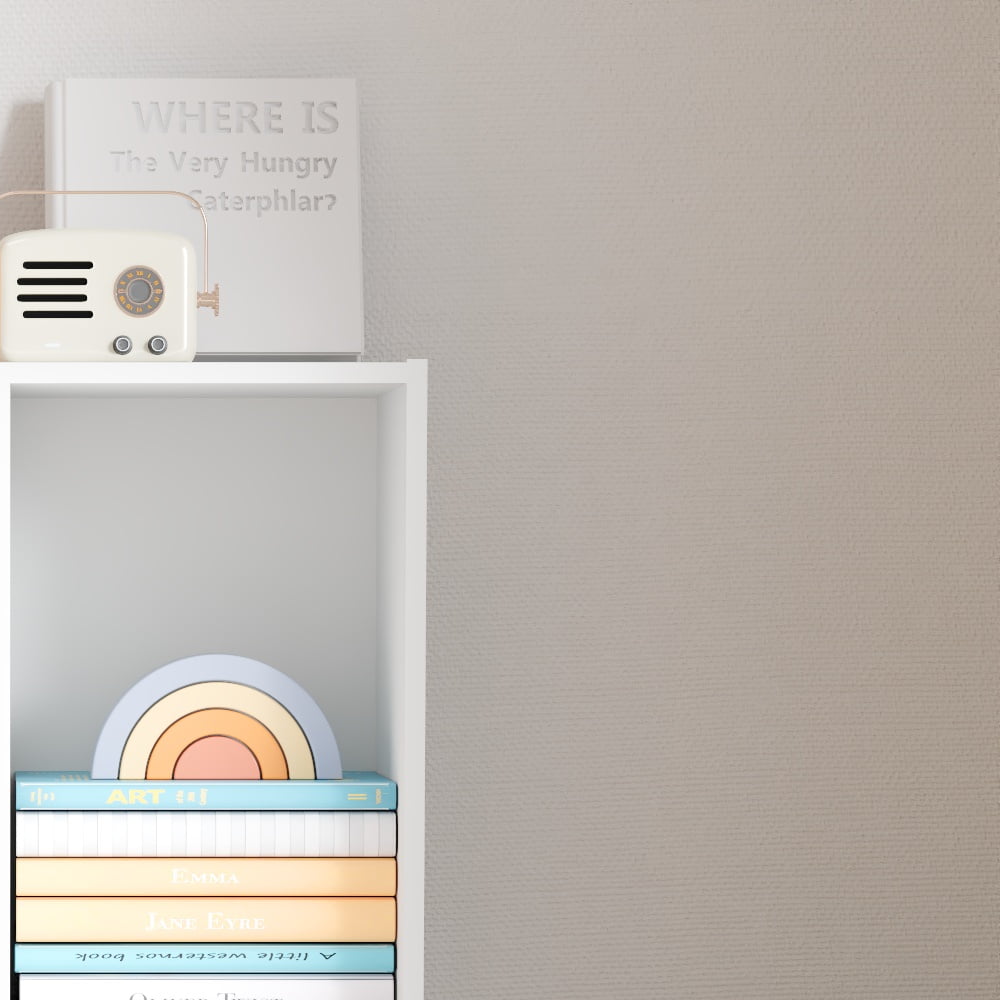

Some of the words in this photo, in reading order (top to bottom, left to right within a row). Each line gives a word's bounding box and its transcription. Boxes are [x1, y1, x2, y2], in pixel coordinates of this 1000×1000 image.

[131, 100, 284, 135] WHERE
[301, 100, 339, 135] IS
[109, 150, 159, 173] The
[168, 151, 228, 178] Very
[240, 151, 338, 179] Hungry
[105, 788, 166, 805] ART
[74, 950, 126, 962] book
[135, 951, 248, 961] westernos
[257, 951, 309, 962] little
[318, 951, 338, 961] A
